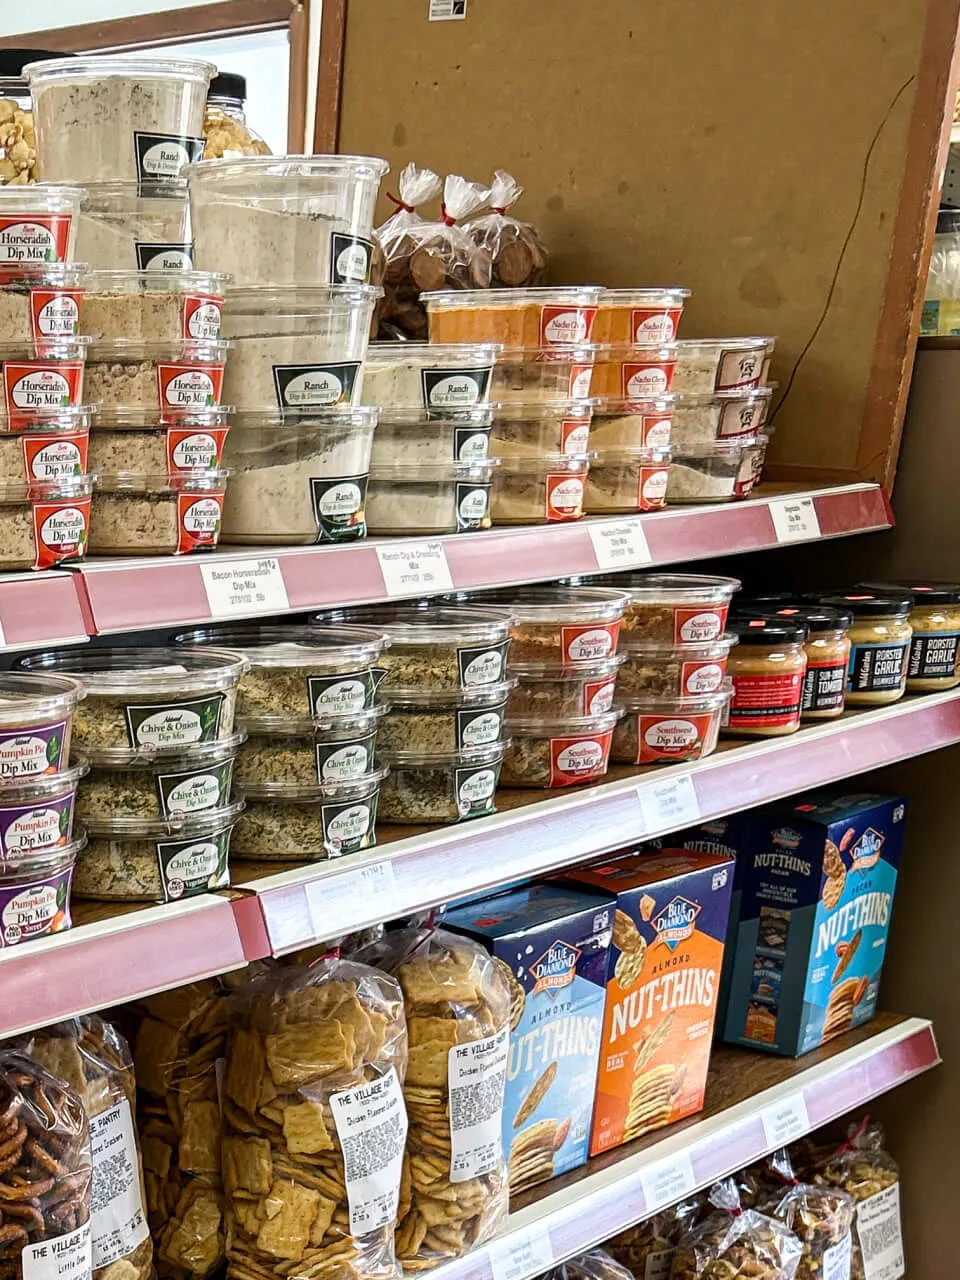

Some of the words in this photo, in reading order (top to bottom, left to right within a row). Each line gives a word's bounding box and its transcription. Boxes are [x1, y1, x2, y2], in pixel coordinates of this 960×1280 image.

[1, 232, 51, 245] Horseradish
[8, 247, 25, 261] Dip
[27, 247, 44, 258] Mix
[304, 381, 329, 391] Ranch
[448, 384, 468, 393] Ranch
[212, 571, 232, 580] Bacon
[233, 582, 244, 591] Dip
[245, 581, 256, 589] Mix
[876, 648, 901, 660] ROASTED
[875, 660, 901, 674] GARLIC
[142, 724, 165, 733] Chive
[167, 723, 172, 731] &
[175, 720, 197, 729] Onion
[657, 726, 692, 734] Southwest
[656, 736, 671, 746] Dip
[673, 735, 687, 744] Mix
[754, 854, 811, 876] NUT-THINS
[668, 904, 687, 917] BLUE
[657, 908, 695, 931] DIAMOND
[815, 892, 890, 958] NUT-THINS
[652, 954, 691, 974] ALMOND
[609, 969, 716, 1043] NUT-THINS
[338, 1093, 352, 1106] THE
[355, 1083, 382, 1101] VILLAGE
